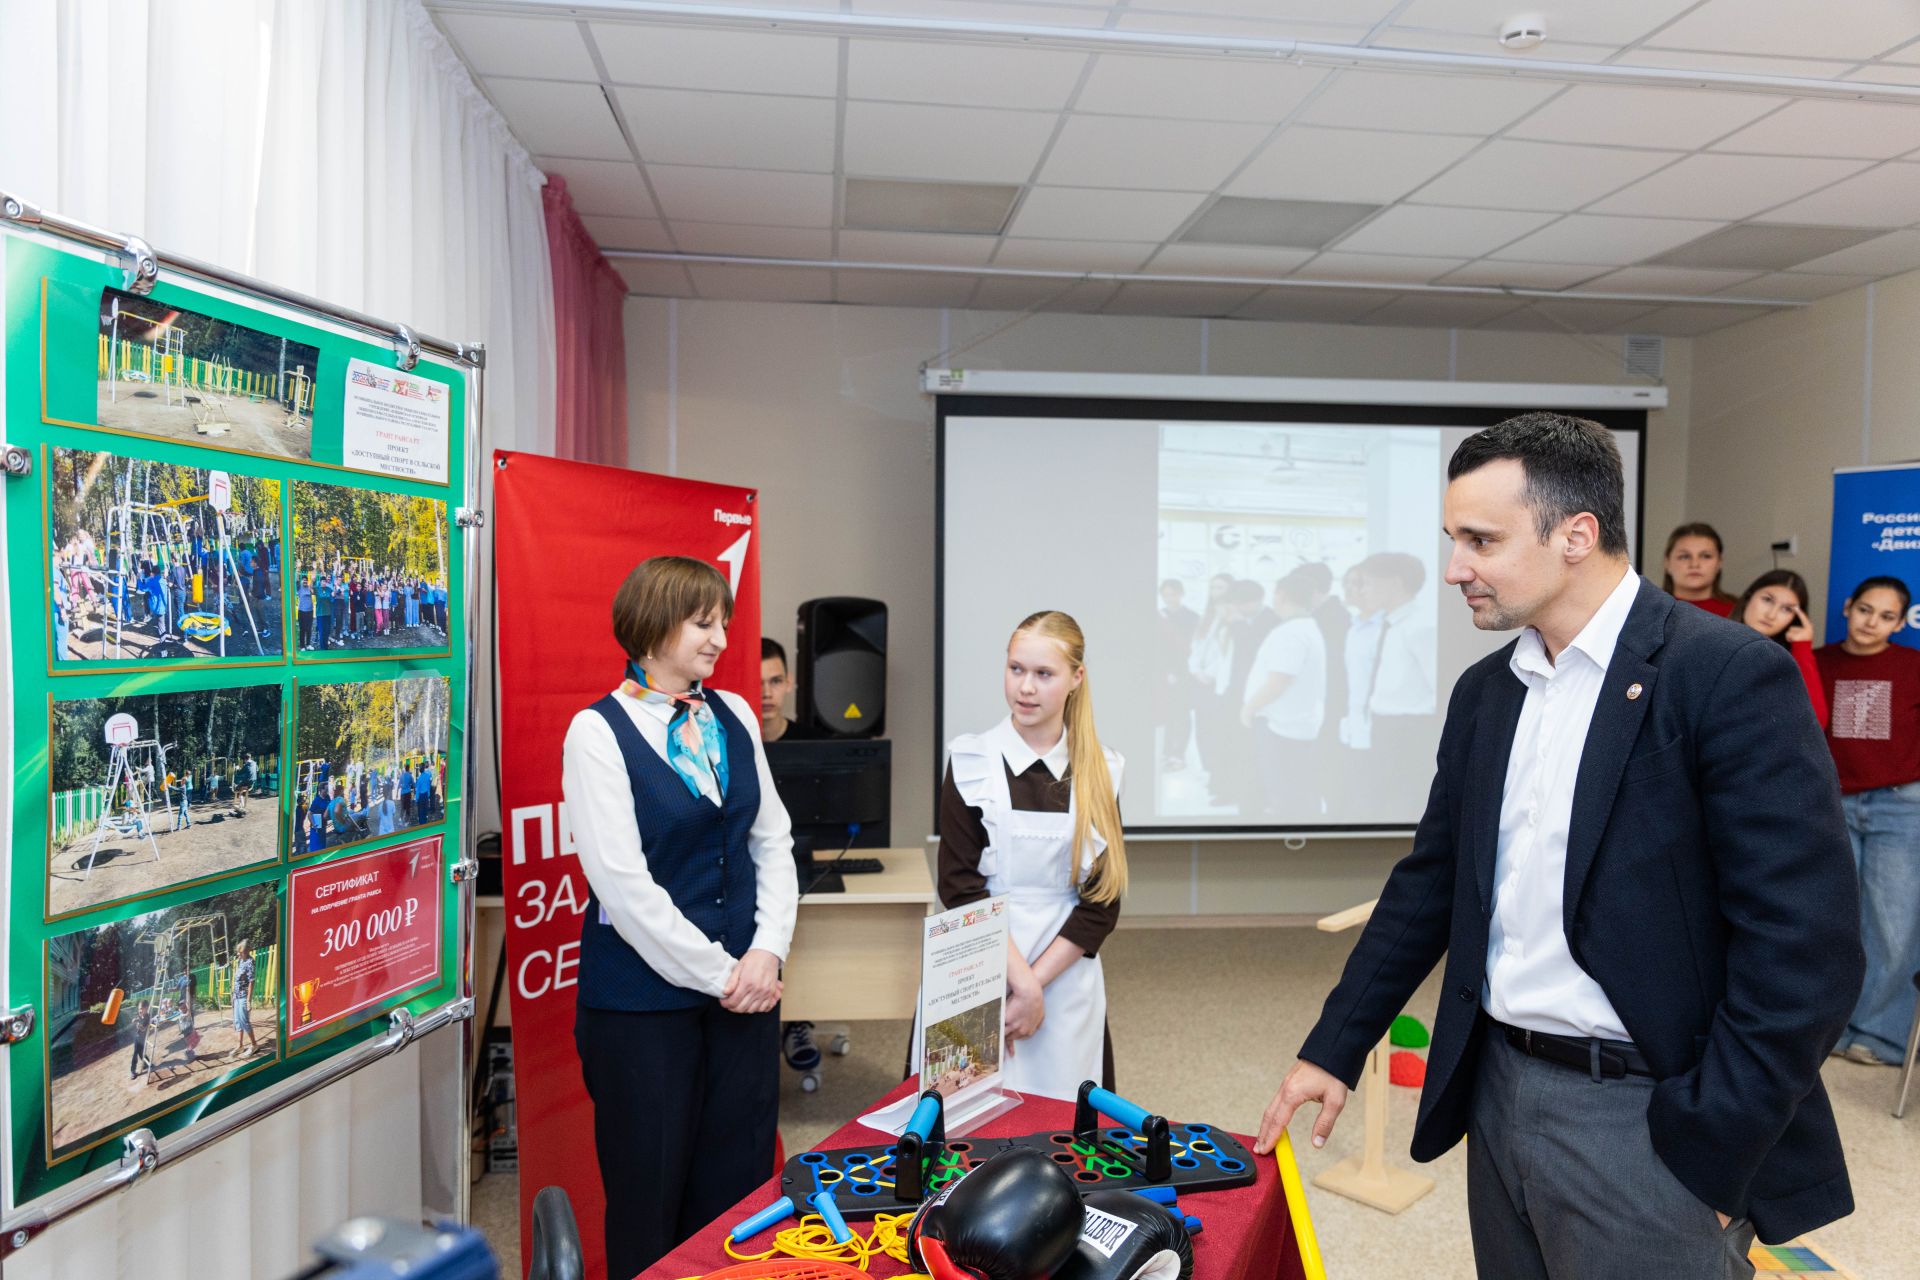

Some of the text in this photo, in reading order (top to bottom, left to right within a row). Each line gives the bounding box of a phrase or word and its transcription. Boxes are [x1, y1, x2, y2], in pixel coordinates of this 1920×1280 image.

[387, 443, 409, 454] ПРОЕКТ
[315, 871, 380, 899] СЕРТИФИКАТ
[514, 873, 590, 929] ЗА
[320, 919, 361, 957] 300
